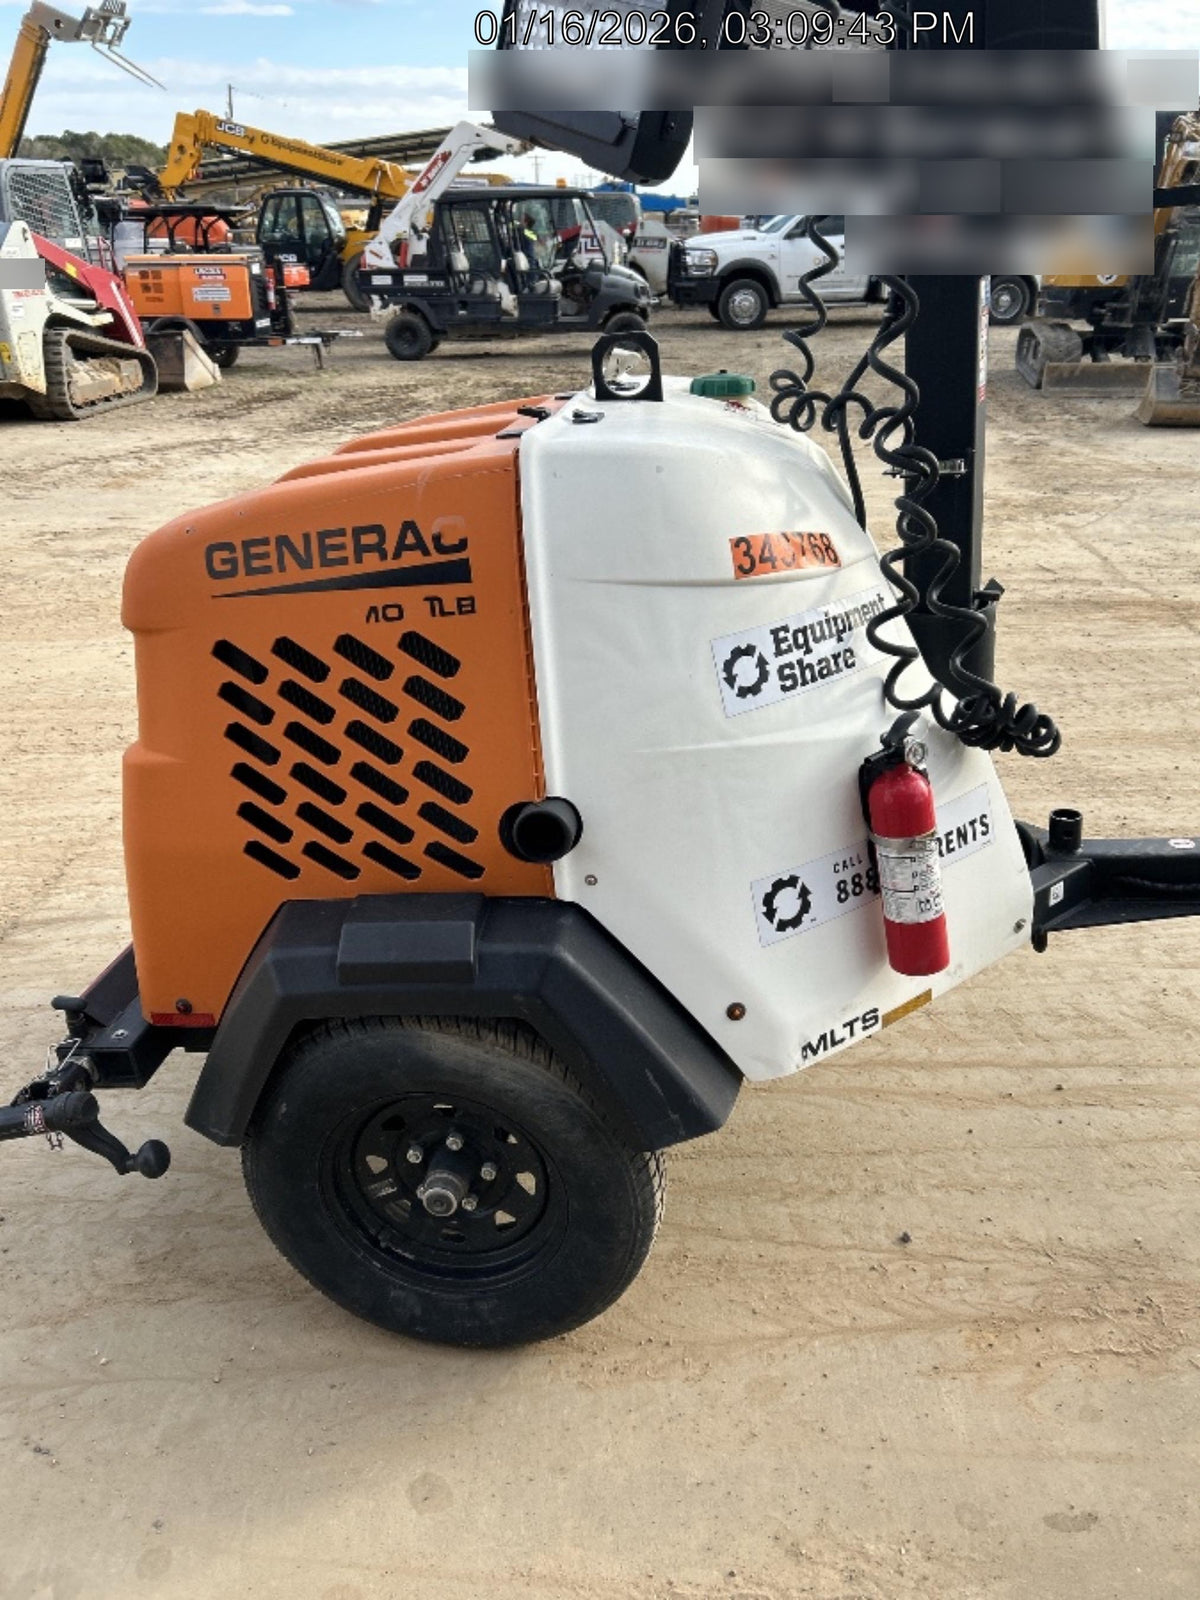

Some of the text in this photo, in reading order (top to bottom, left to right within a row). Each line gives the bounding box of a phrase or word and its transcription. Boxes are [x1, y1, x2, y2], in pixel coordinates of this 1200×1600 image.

[216, 122, 245, 137] JCB
[205, 515, 468, 580] GENERAC
[770, 593, 886, 658] Equipment
[777, 646, 857, 693] Share
[833, 853, 863, 874] CALL
